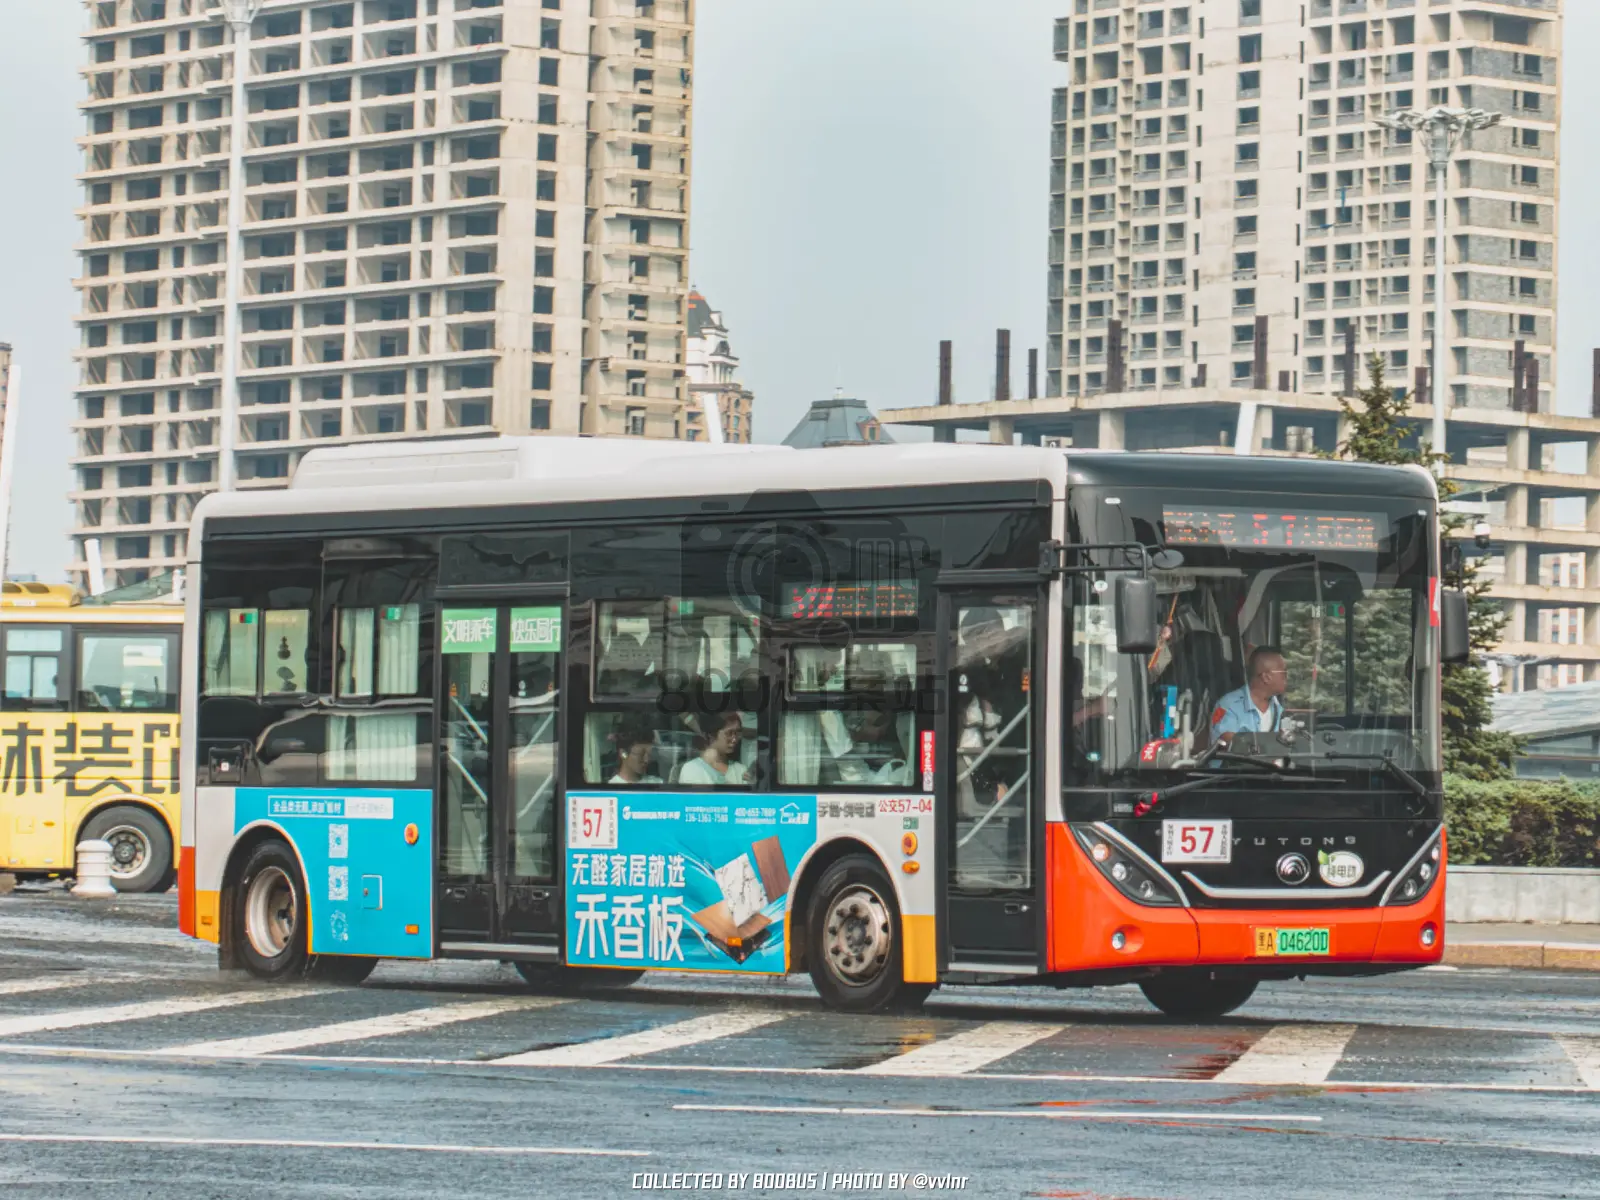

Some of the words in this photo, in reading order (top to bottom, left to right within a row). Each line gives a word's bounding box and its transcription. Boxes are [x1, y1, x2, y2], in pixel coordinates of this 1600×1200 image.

[879, 799, 933, 813] 公交57-04
[583, 808, 603, 838] 57
[1180, 826, 1215, 854] 57
[571, 853, 687, 888] 无醛家居就选
[574, 893, 685, 962] 禾香板
